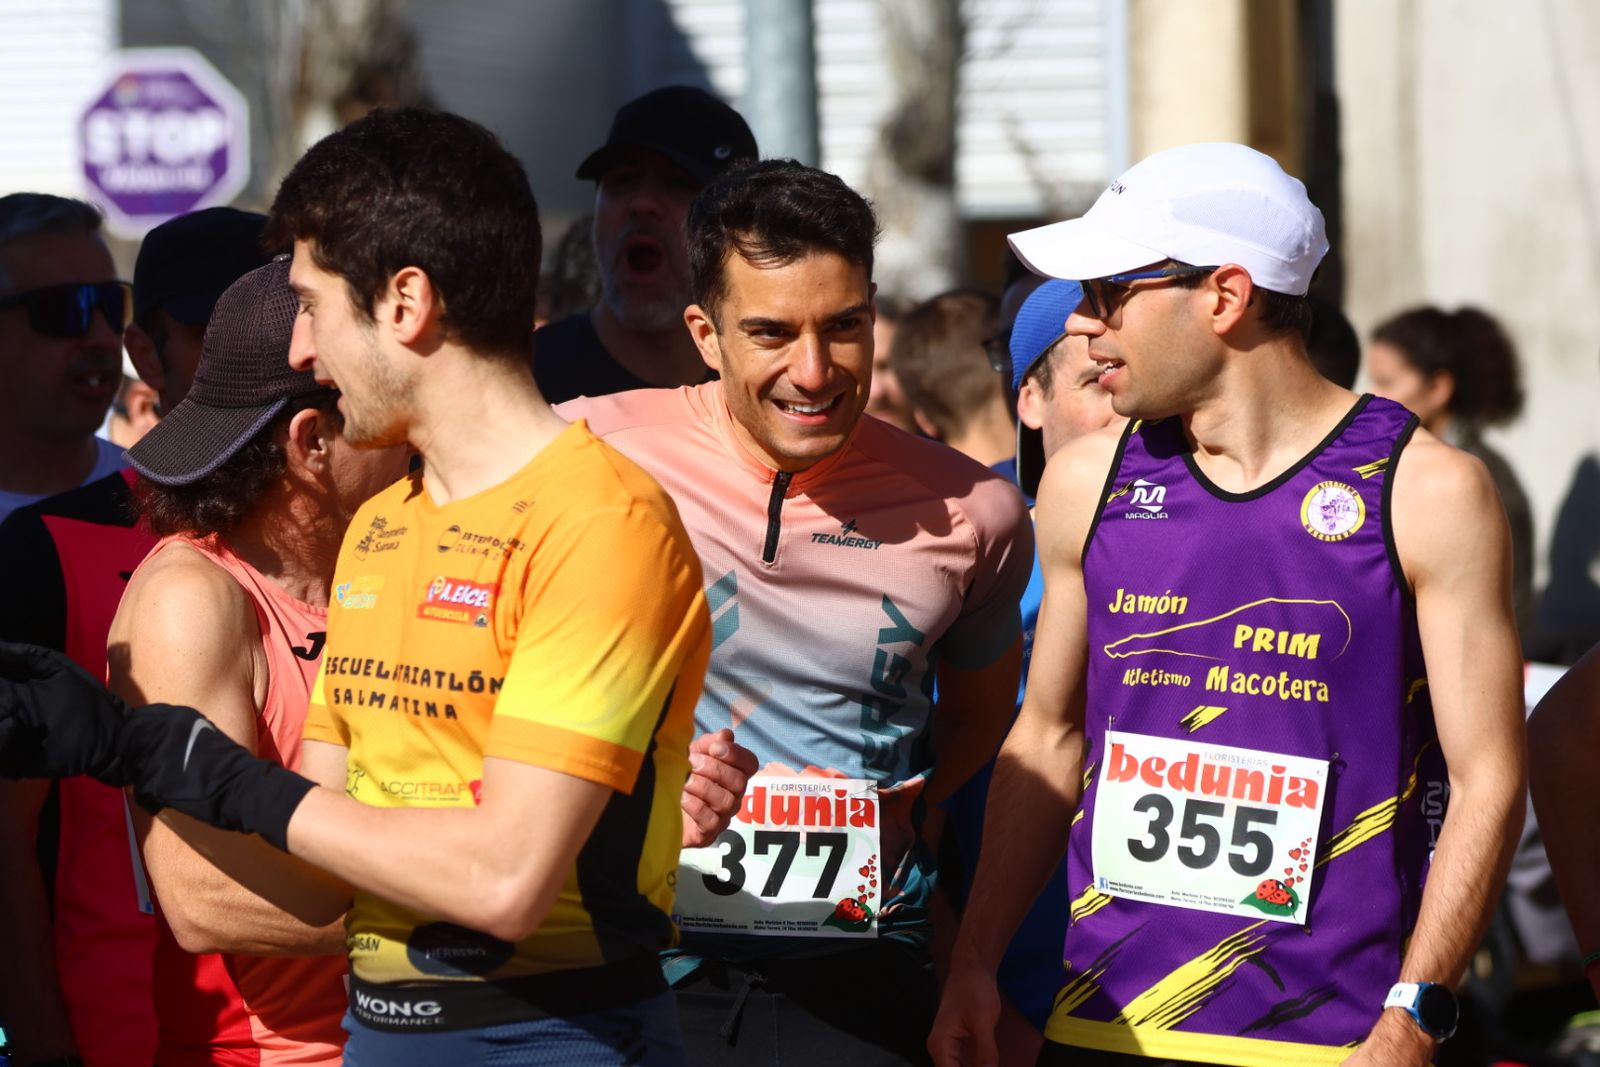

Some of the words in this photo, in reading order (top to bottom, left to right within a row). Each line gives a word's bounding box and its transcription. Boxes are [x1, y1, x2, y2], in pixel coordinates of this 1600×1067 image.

[83, 107, 224, 164] STOP
[1124, 511, 1169, 520] MAGLIA
[811, 532, 882, 551] TEAMERGY
[1108, 588, 1188, 615] Jamón
[1234, 624, 1321, 660] PRIM
[1122, 668, 1191, 687] Atletismo
[1205, 666, 1329, 702] Macotera
[770, 783, 832, 793] FLORISTERÍAS
[1106, 743, 1320, 810] bedunia
[1127, 793, 1279, 877] 355
[702, 829, 849, 899] 377
[354, 989, 442, 1016] WONG
[355, 1005, 447, 1026] PERFORMANCE
